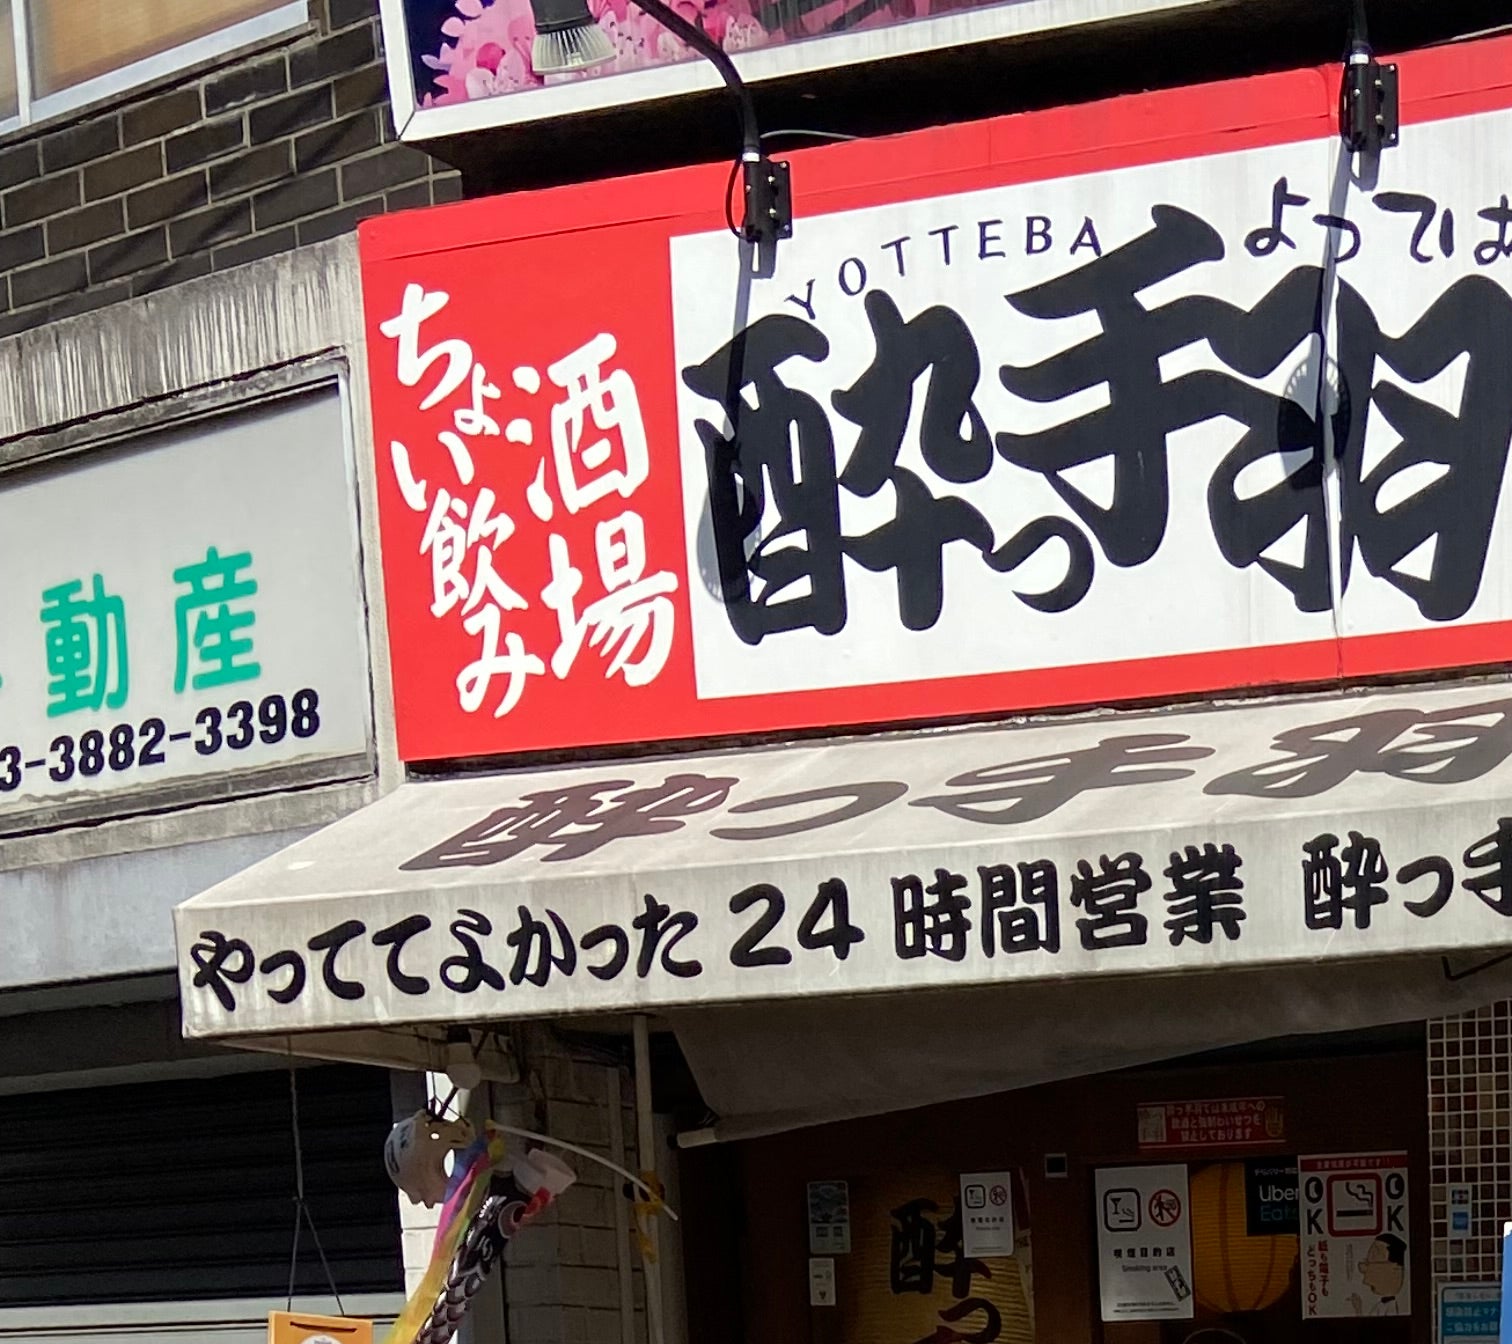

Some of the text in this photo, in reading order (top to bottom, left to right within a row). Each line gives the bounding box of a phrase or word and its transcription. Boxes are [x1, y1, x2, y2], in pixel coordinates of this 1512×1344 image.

[784, 214, 1104, 321] YOTTEBA
[380, 283, 546, 718] ちょい飲み
[511, 332, 679, 687] 酒場
[0, 547, 262, 718] 動産
[190, 894, 702, 1012] やっててよかった
